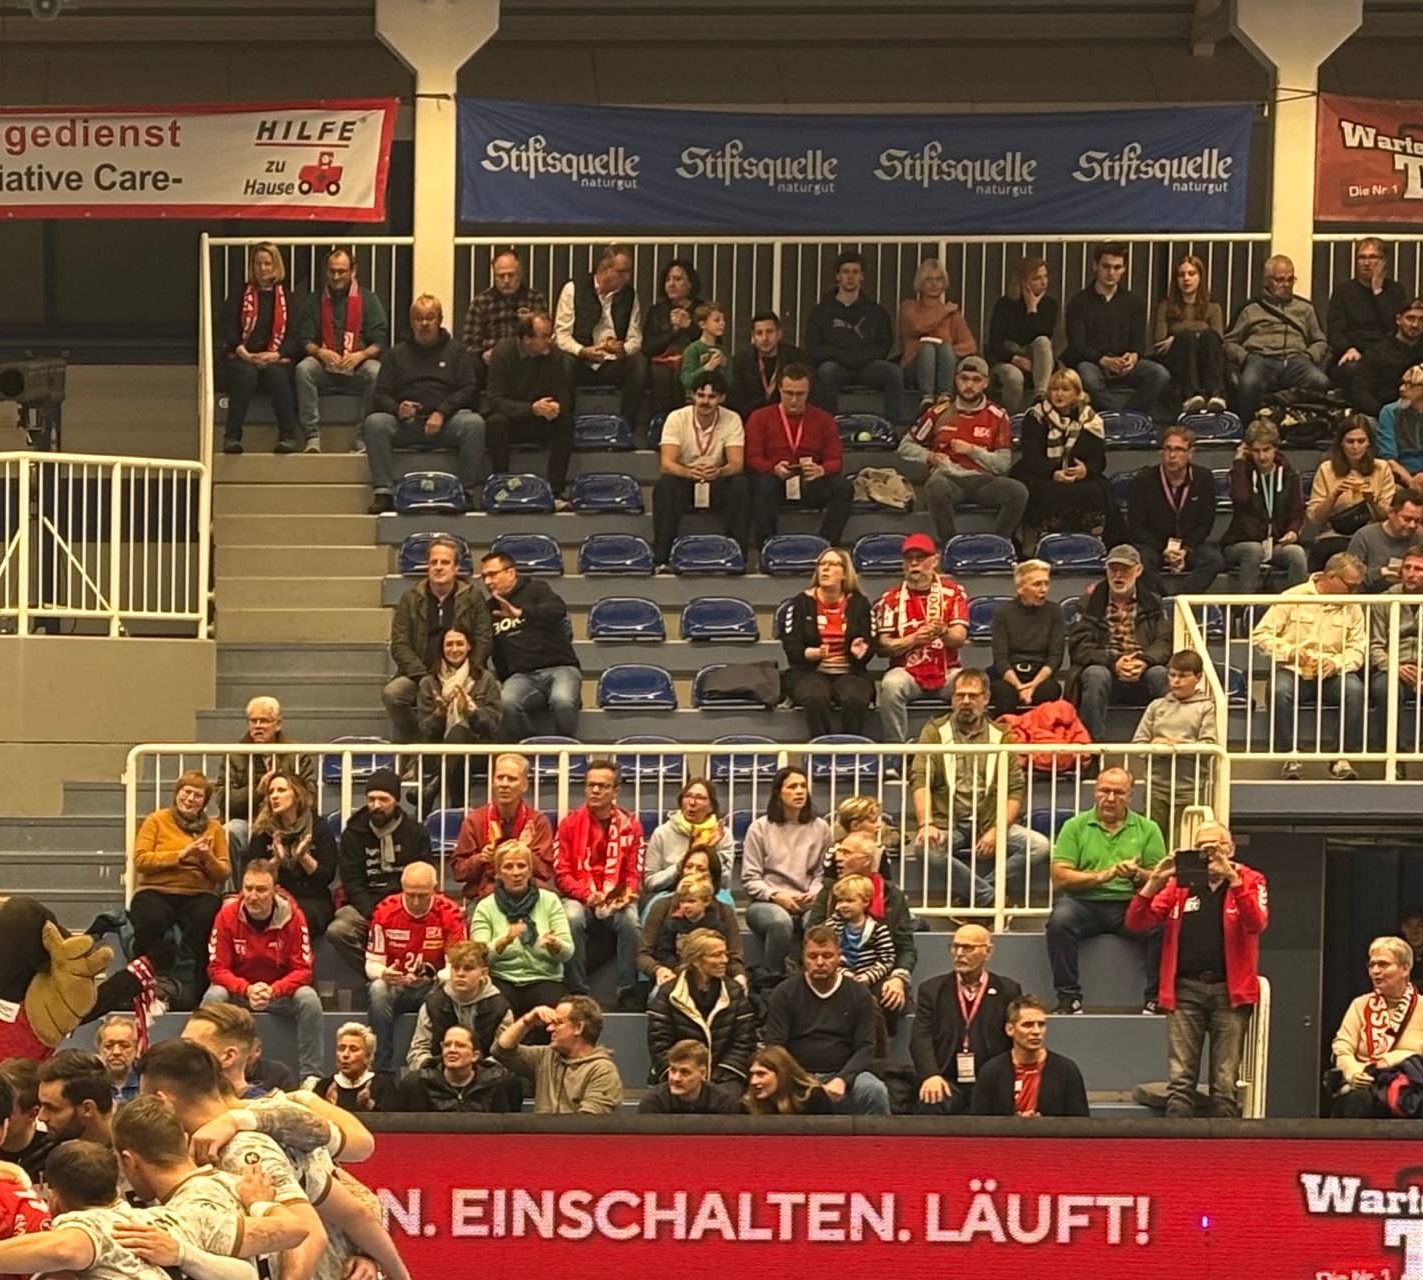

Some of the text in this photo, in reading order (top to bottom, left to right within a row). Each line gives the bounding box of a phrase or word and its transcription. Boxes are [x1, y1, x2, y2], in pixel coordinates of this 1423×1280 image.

[256, 121, 357, 141] HILFE
[265, 160, 286, 173] zu
[481, 134, 641, 182] Stiftsquelle
[675, 139, 838, 187] Stiftsquelle
[873, 140, 1038, 189] Stiftsquelle
[1072, 142, 1233, 187] Stiftsquelle
[94, 163, 183, 192] Care-
[243, 179, 295, 195] Hause
[581, 177, 638, 191] naturgut
[778, 182, 835, 196] naturgut
[1172, 181, 1229, 195] naturgut
[976, 184, 1034, 197] naturgut
[1299, 1172, 1423, 1215] Wart
[451, 1187, 911, 1242] EINSCHALTEN.
[926, 1178, 1151, 1246] LÄUFT!
